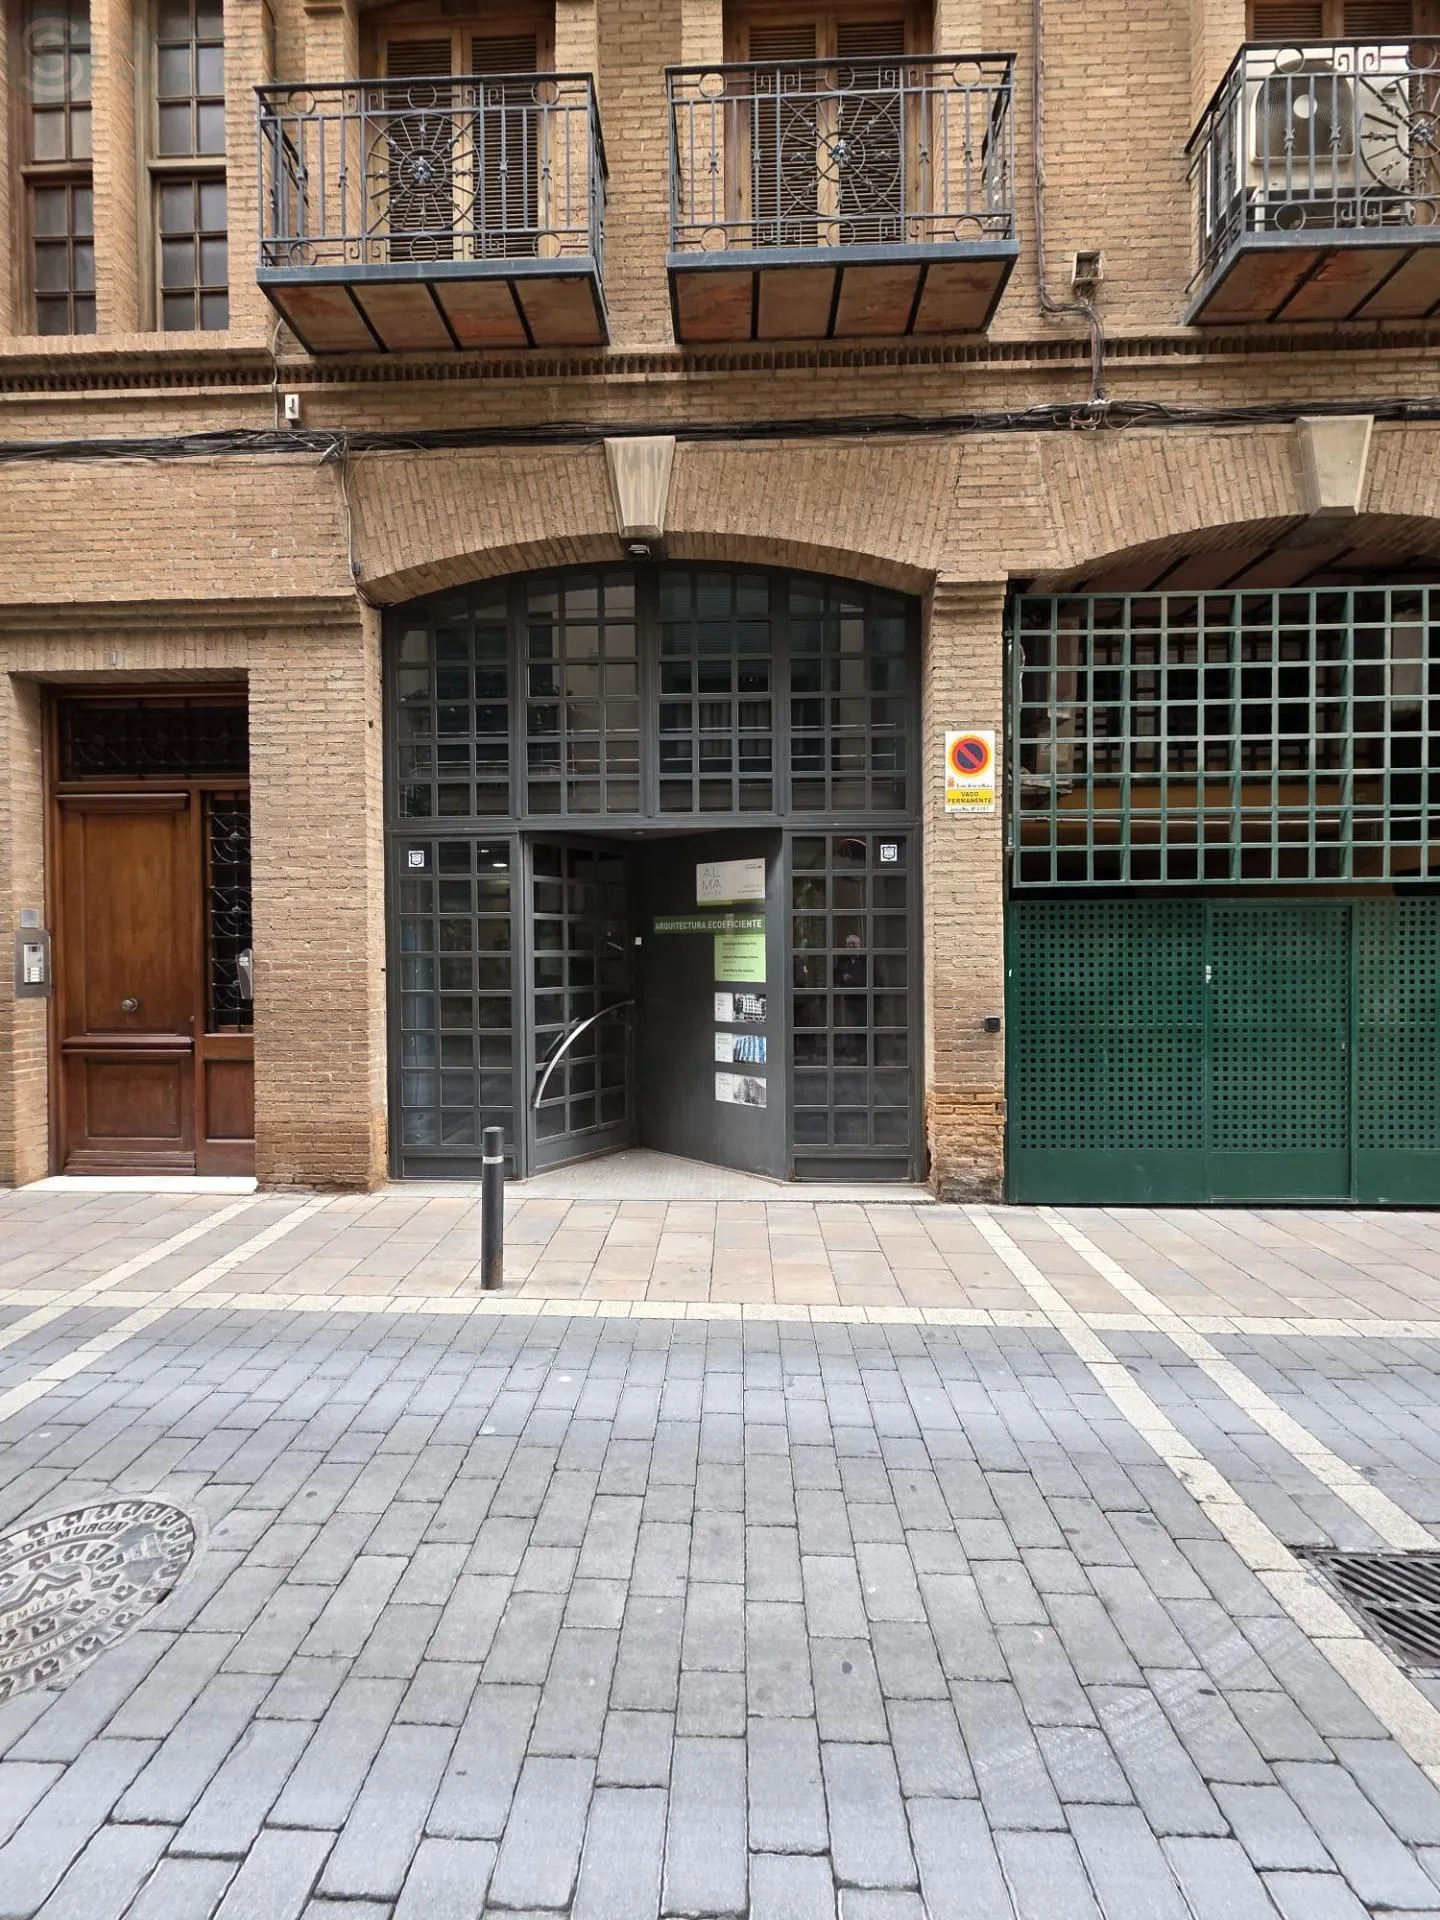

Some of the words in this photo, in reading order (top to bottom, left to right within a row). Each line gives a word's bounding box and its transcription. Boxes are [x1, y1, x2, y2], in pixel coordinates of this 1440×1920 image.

[703, 867, 720, 878] AL
[703, 879, 721, 890] MA
[655, 920, 707, 931] ARQUITECTURA
[707, 919, 762, 930] ECOEFICIENTE
[21, 1537, 46, 1553] DE
[54, 1521, 125, 1541] MURCIA
[6, 1587, 78, 1627] EMUASA
